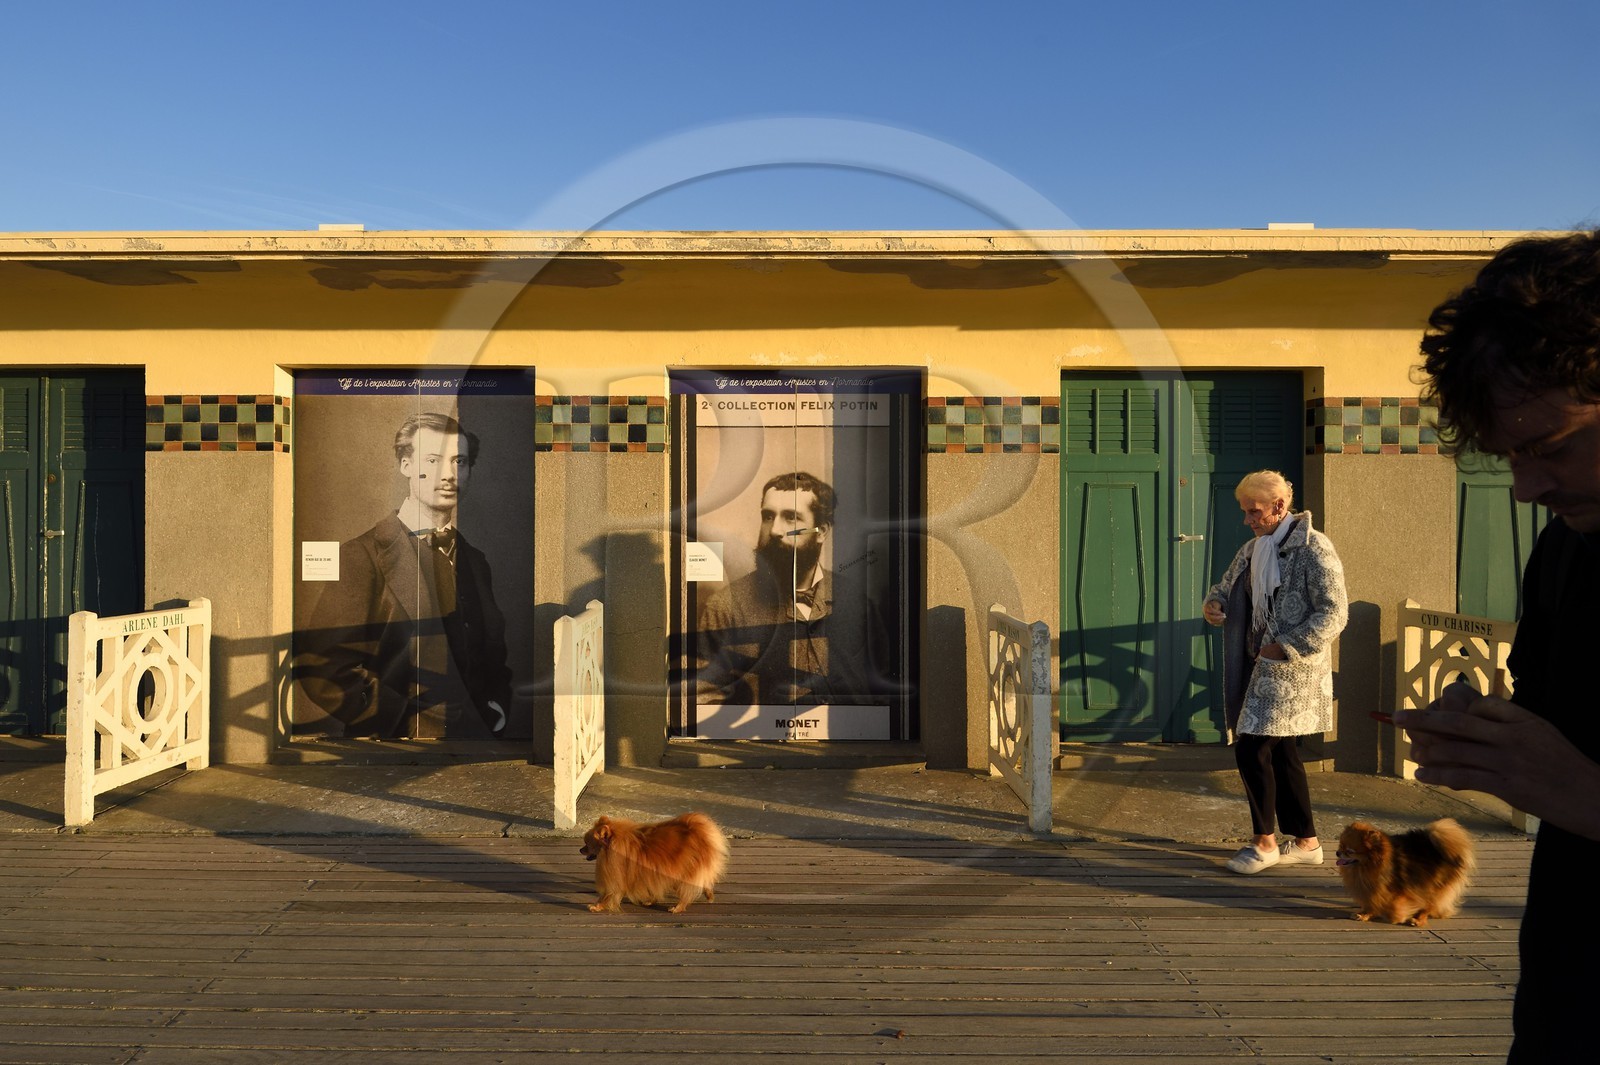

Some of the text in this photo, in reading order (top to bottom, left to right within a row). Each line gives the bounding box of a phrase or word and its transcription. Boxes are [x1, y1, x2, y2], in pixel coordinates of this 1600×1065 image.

[353, 379, 363, 388] de
[364, 378, 407, 390] l'exposition
[408, 377, 441, 390] Artistes
[454, 378, 498, 389] Normandie
[729, 379, 740, 387] de
[784, 377, 817, 389] Artistes
[829, 376, 874, 387] Normandie
[717, 401, 796, 411] COLLECTION
[801, 401, 835, 410] FELIX
[840, 401, 878, 410] POTIN
[122, 613, 185, 633] ARLENE DAHL
[1421, 613, 1493, 636] CYD CHARISSE
[775, 719, 820, 728] MONET
